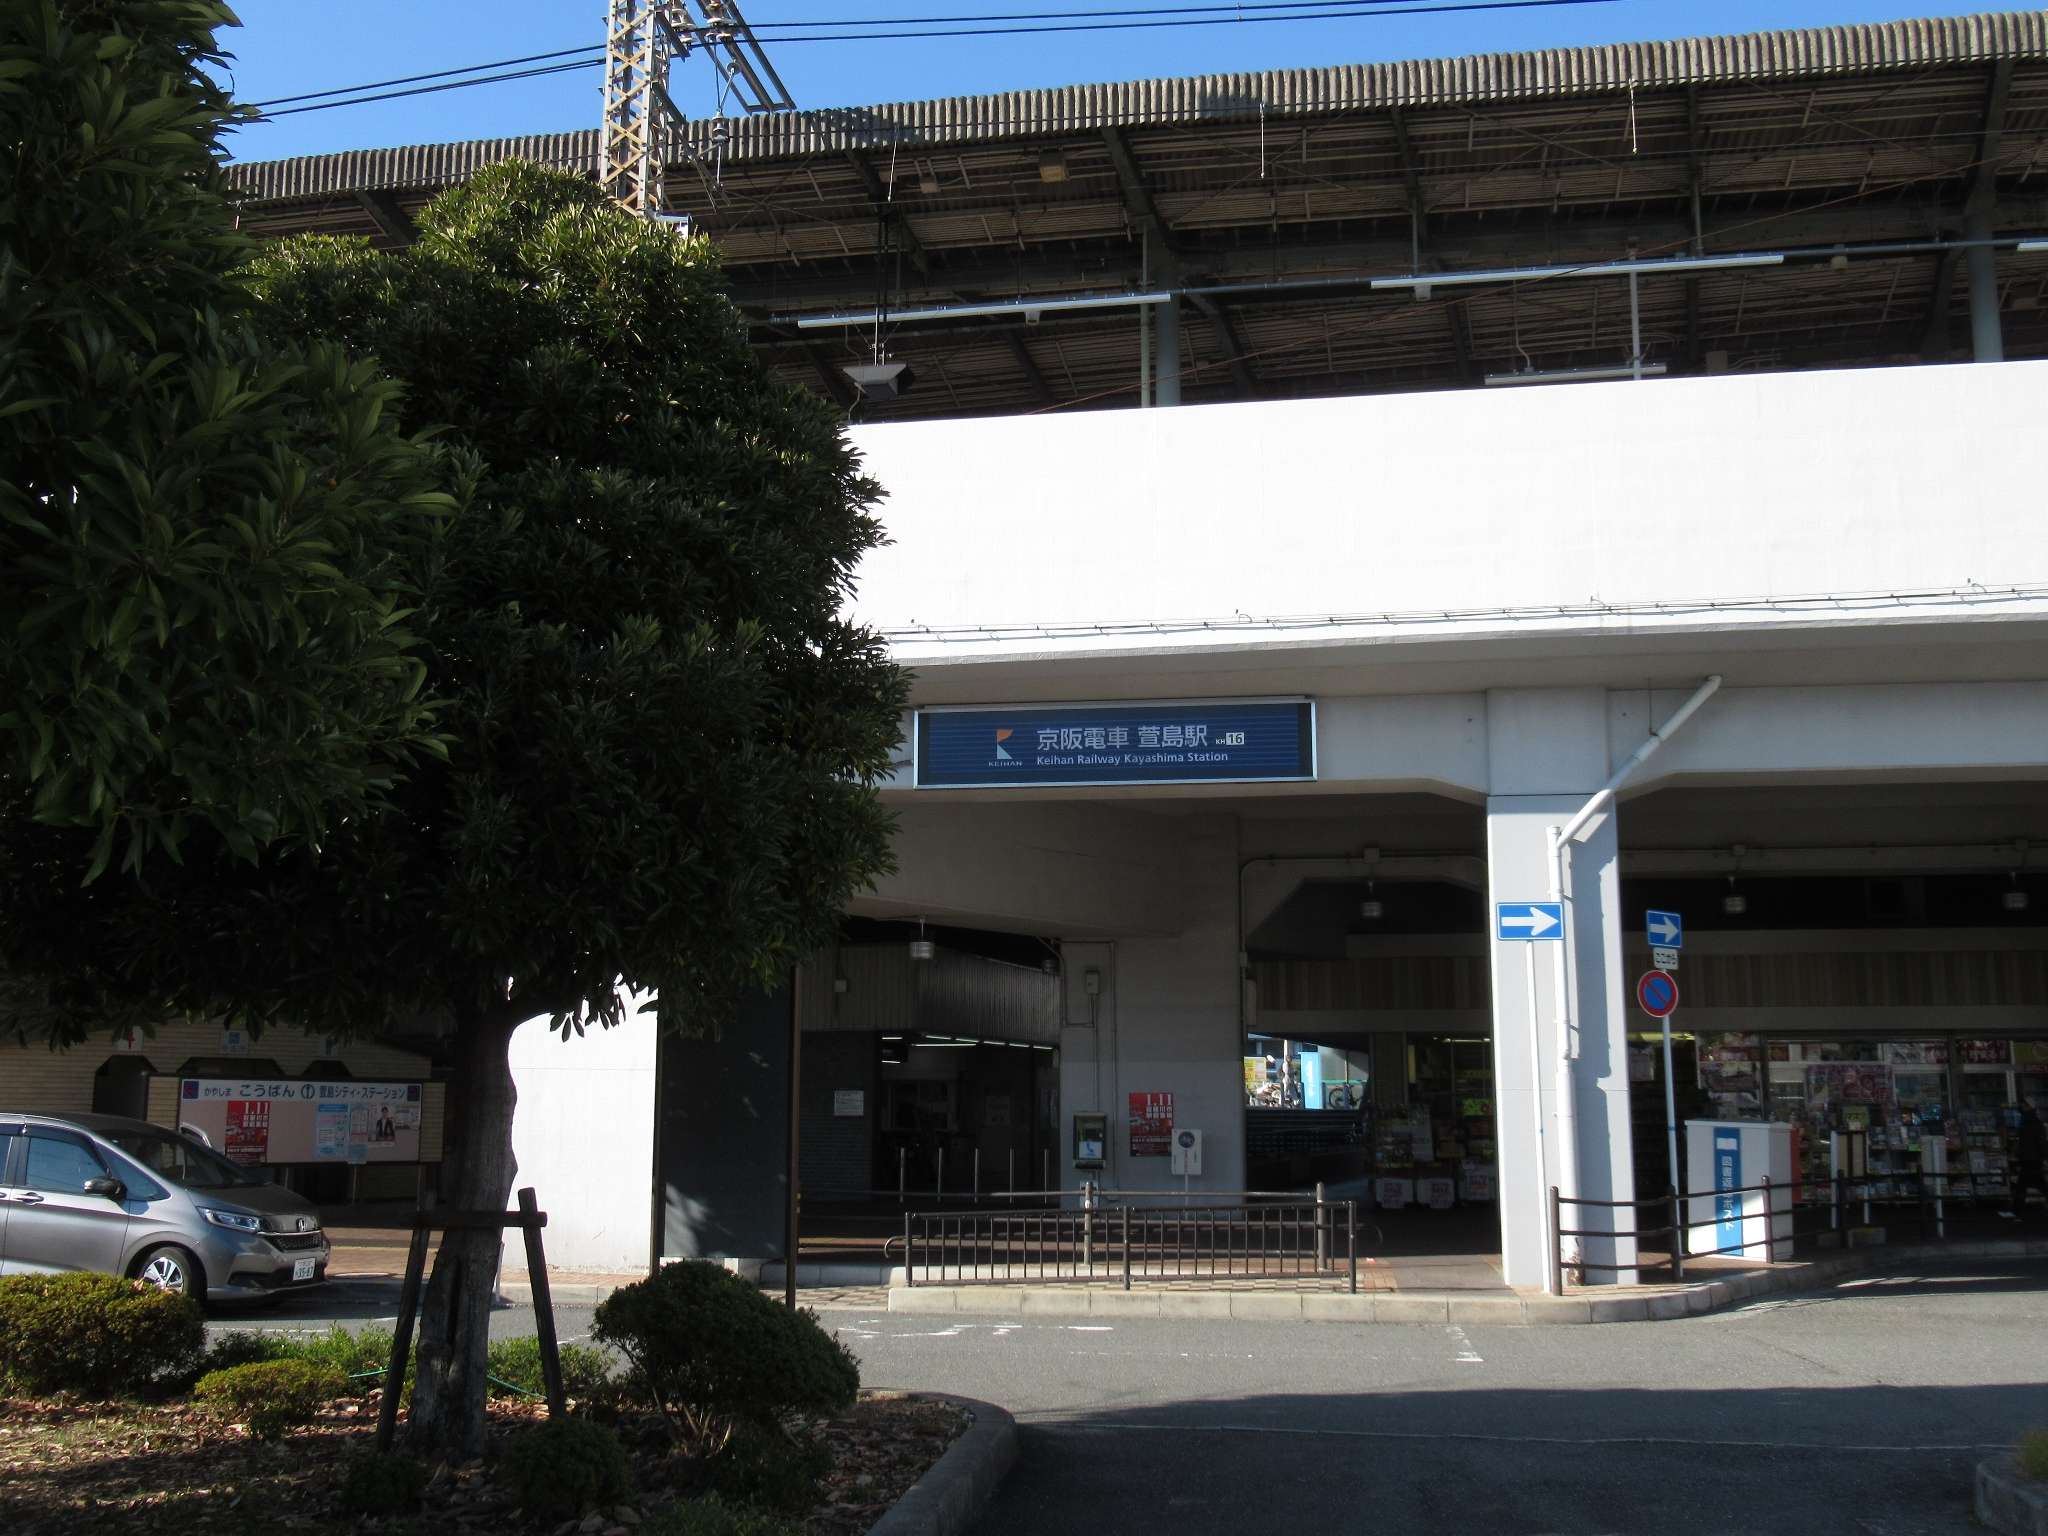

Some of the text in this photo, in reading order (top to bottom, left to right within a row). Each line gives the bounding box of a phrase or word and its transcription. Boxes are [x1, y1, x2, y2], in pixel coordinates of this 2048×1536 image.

[1037, 725, 1207, 751] 京阪電車 萱島駅
[1228, 733, 1242, 744] 16
[1036, 751, 1228, 767] Keihan Railway Kayashima Station
[239, 1083, 295, 1098] こうばん
